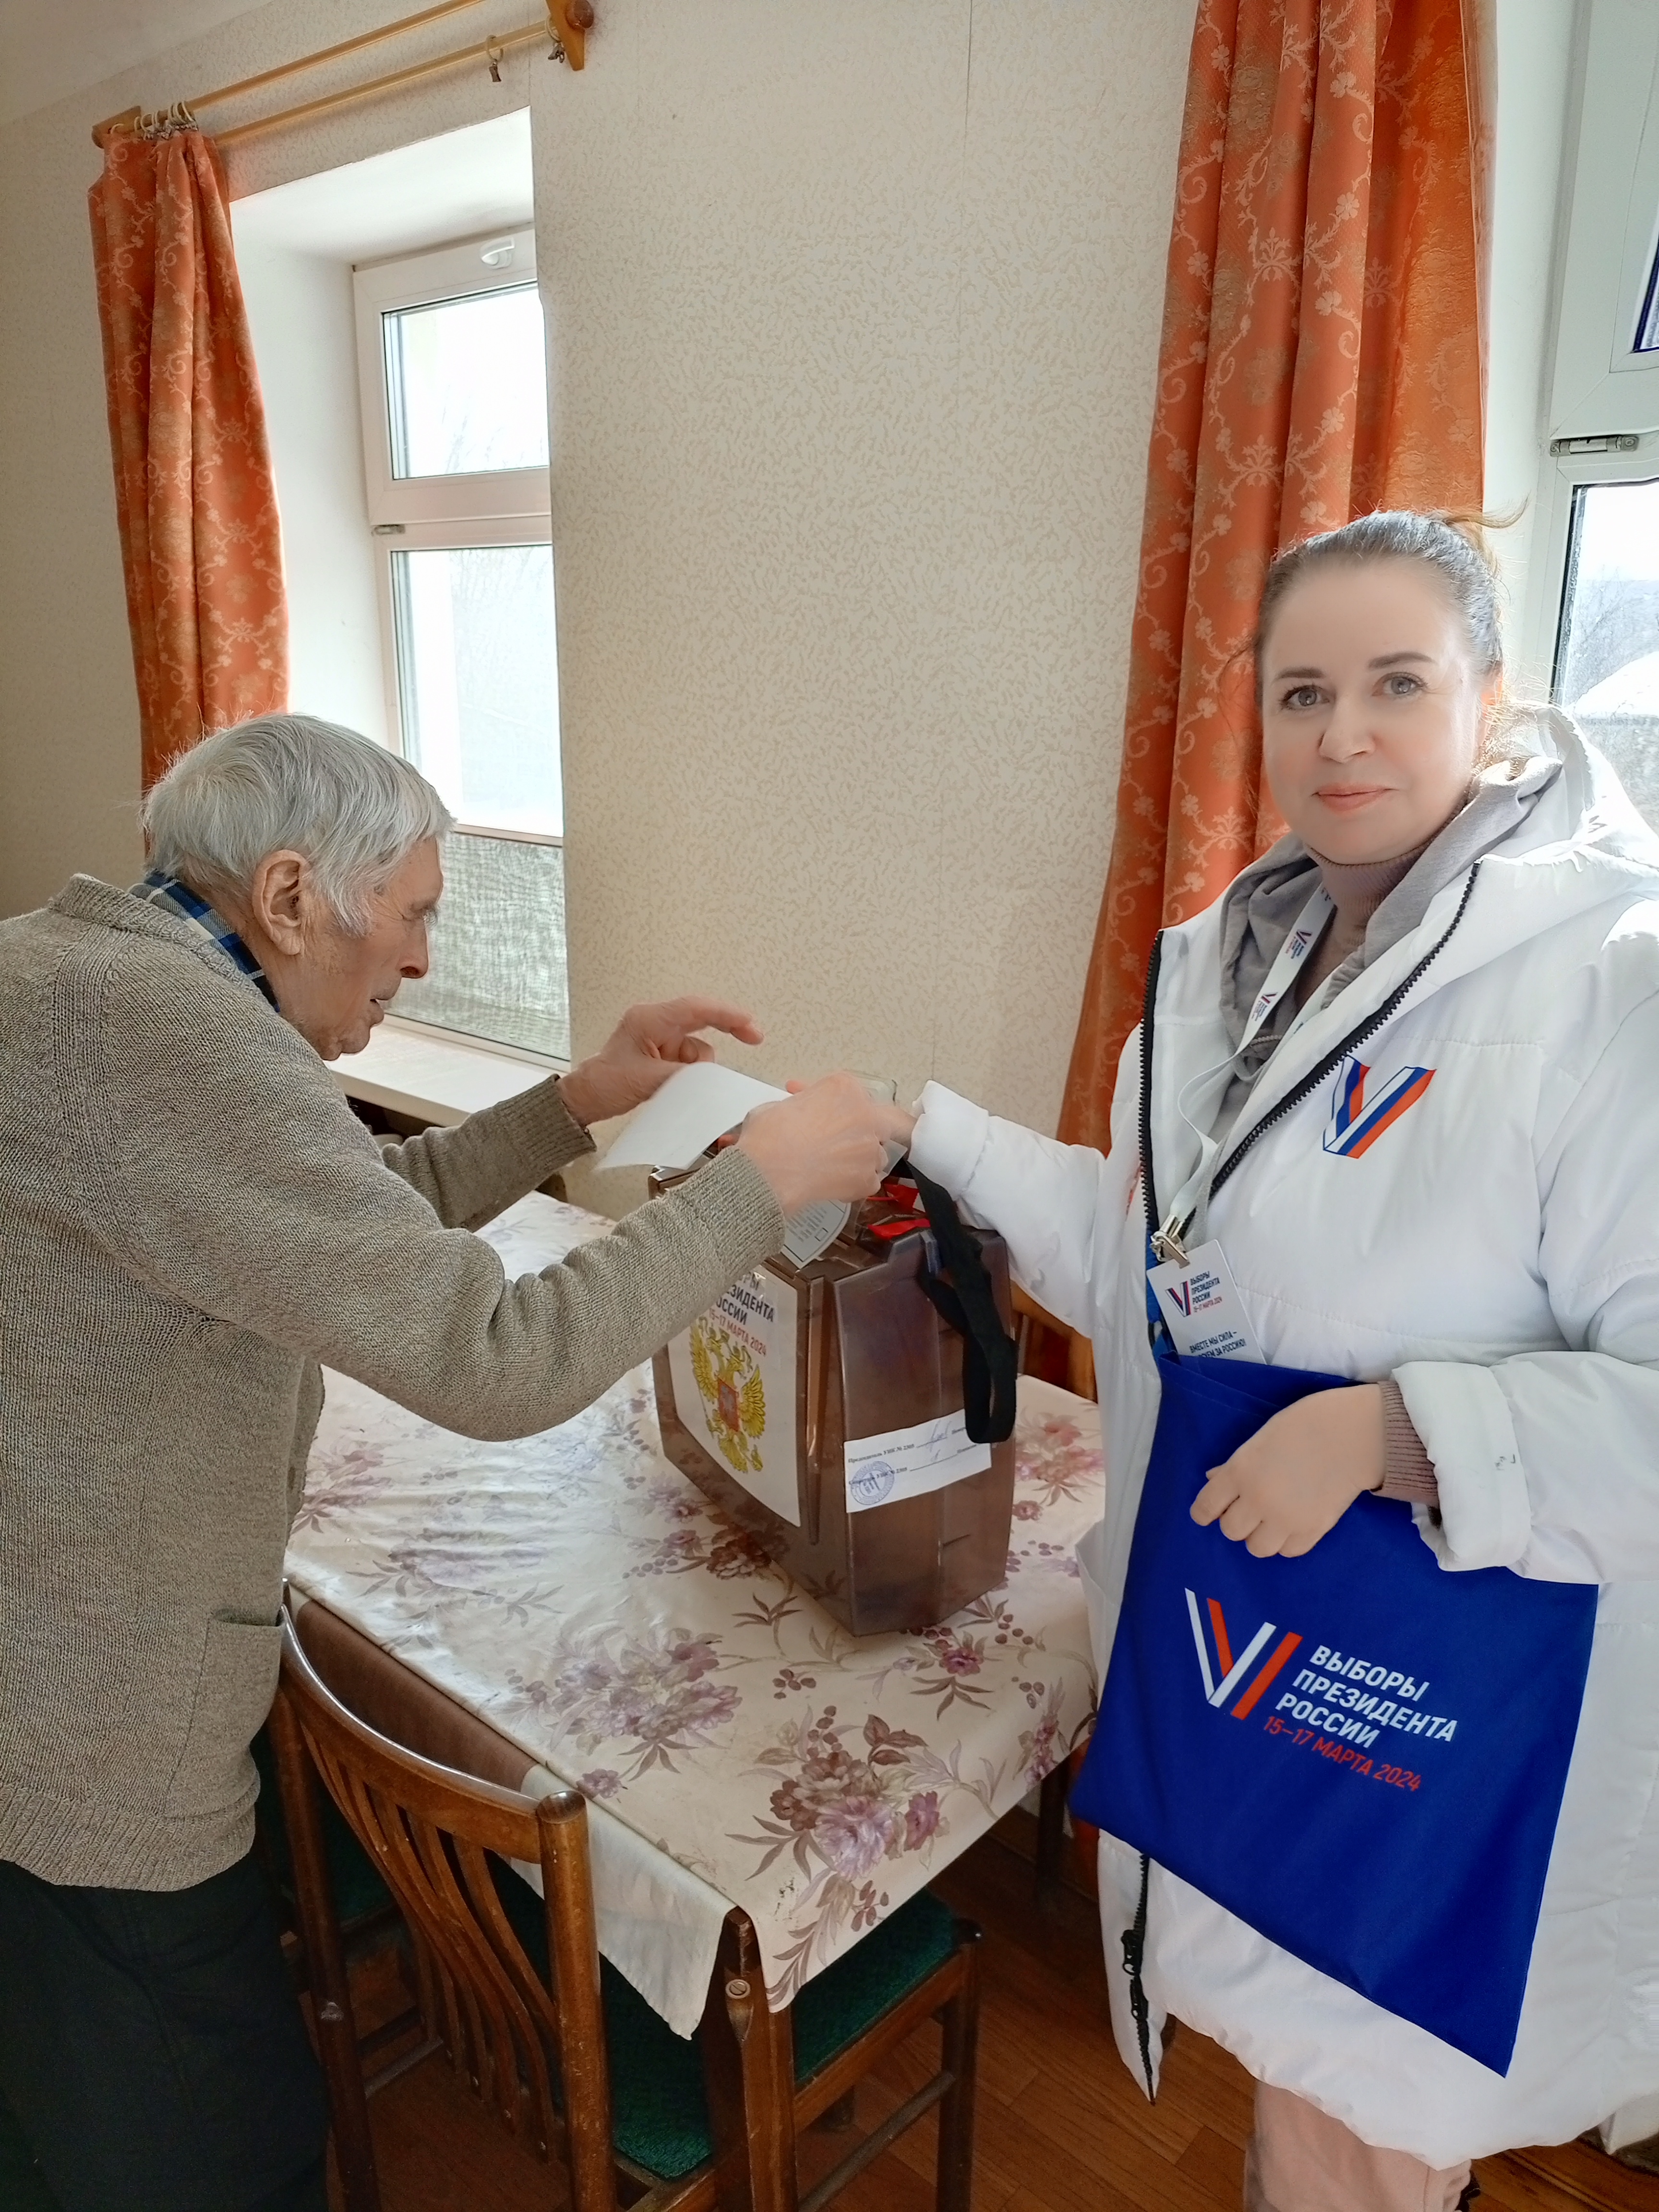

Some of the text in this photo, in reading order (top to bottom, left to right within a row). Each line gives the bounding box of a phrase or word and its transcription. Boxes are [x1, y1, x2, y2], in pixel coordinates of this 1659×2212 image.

[1190, 1271, 1210, 1286] ВЫБОРЫ
[1191, 1277, 1220, 1295] ПРЕЗИДЕНТА
[716, 1297, 747, 1325] ОССИИ
[727, 1284, 774, 1322] ЗИДЕНТА
[1192, 1291, 1210, 1305] РОССИИ
[727, 1320, 749, 1345] МАРТА
[750, 1337, 767, 1357] 2024
[1190, 1340, 1209, 1353] ВМЕСТЕ
[1208, 1336, 1219, 1346] МЫ
[1218, 1331, 1233, 1342] СИЛА
[1215, 1347, 1223, 1356] ЗА
[1310, 1645, 1430, 1702] ВЫБОРЫ
[1275, 1692, 1381, 1749] РОССИИ
[1292, 1669, 1458, 1742] ПРЕЗИДЕНТА
[1311, 1736, 1374, 1777] МАРТА
[1373, 1763, 1422, 1792] 2024
